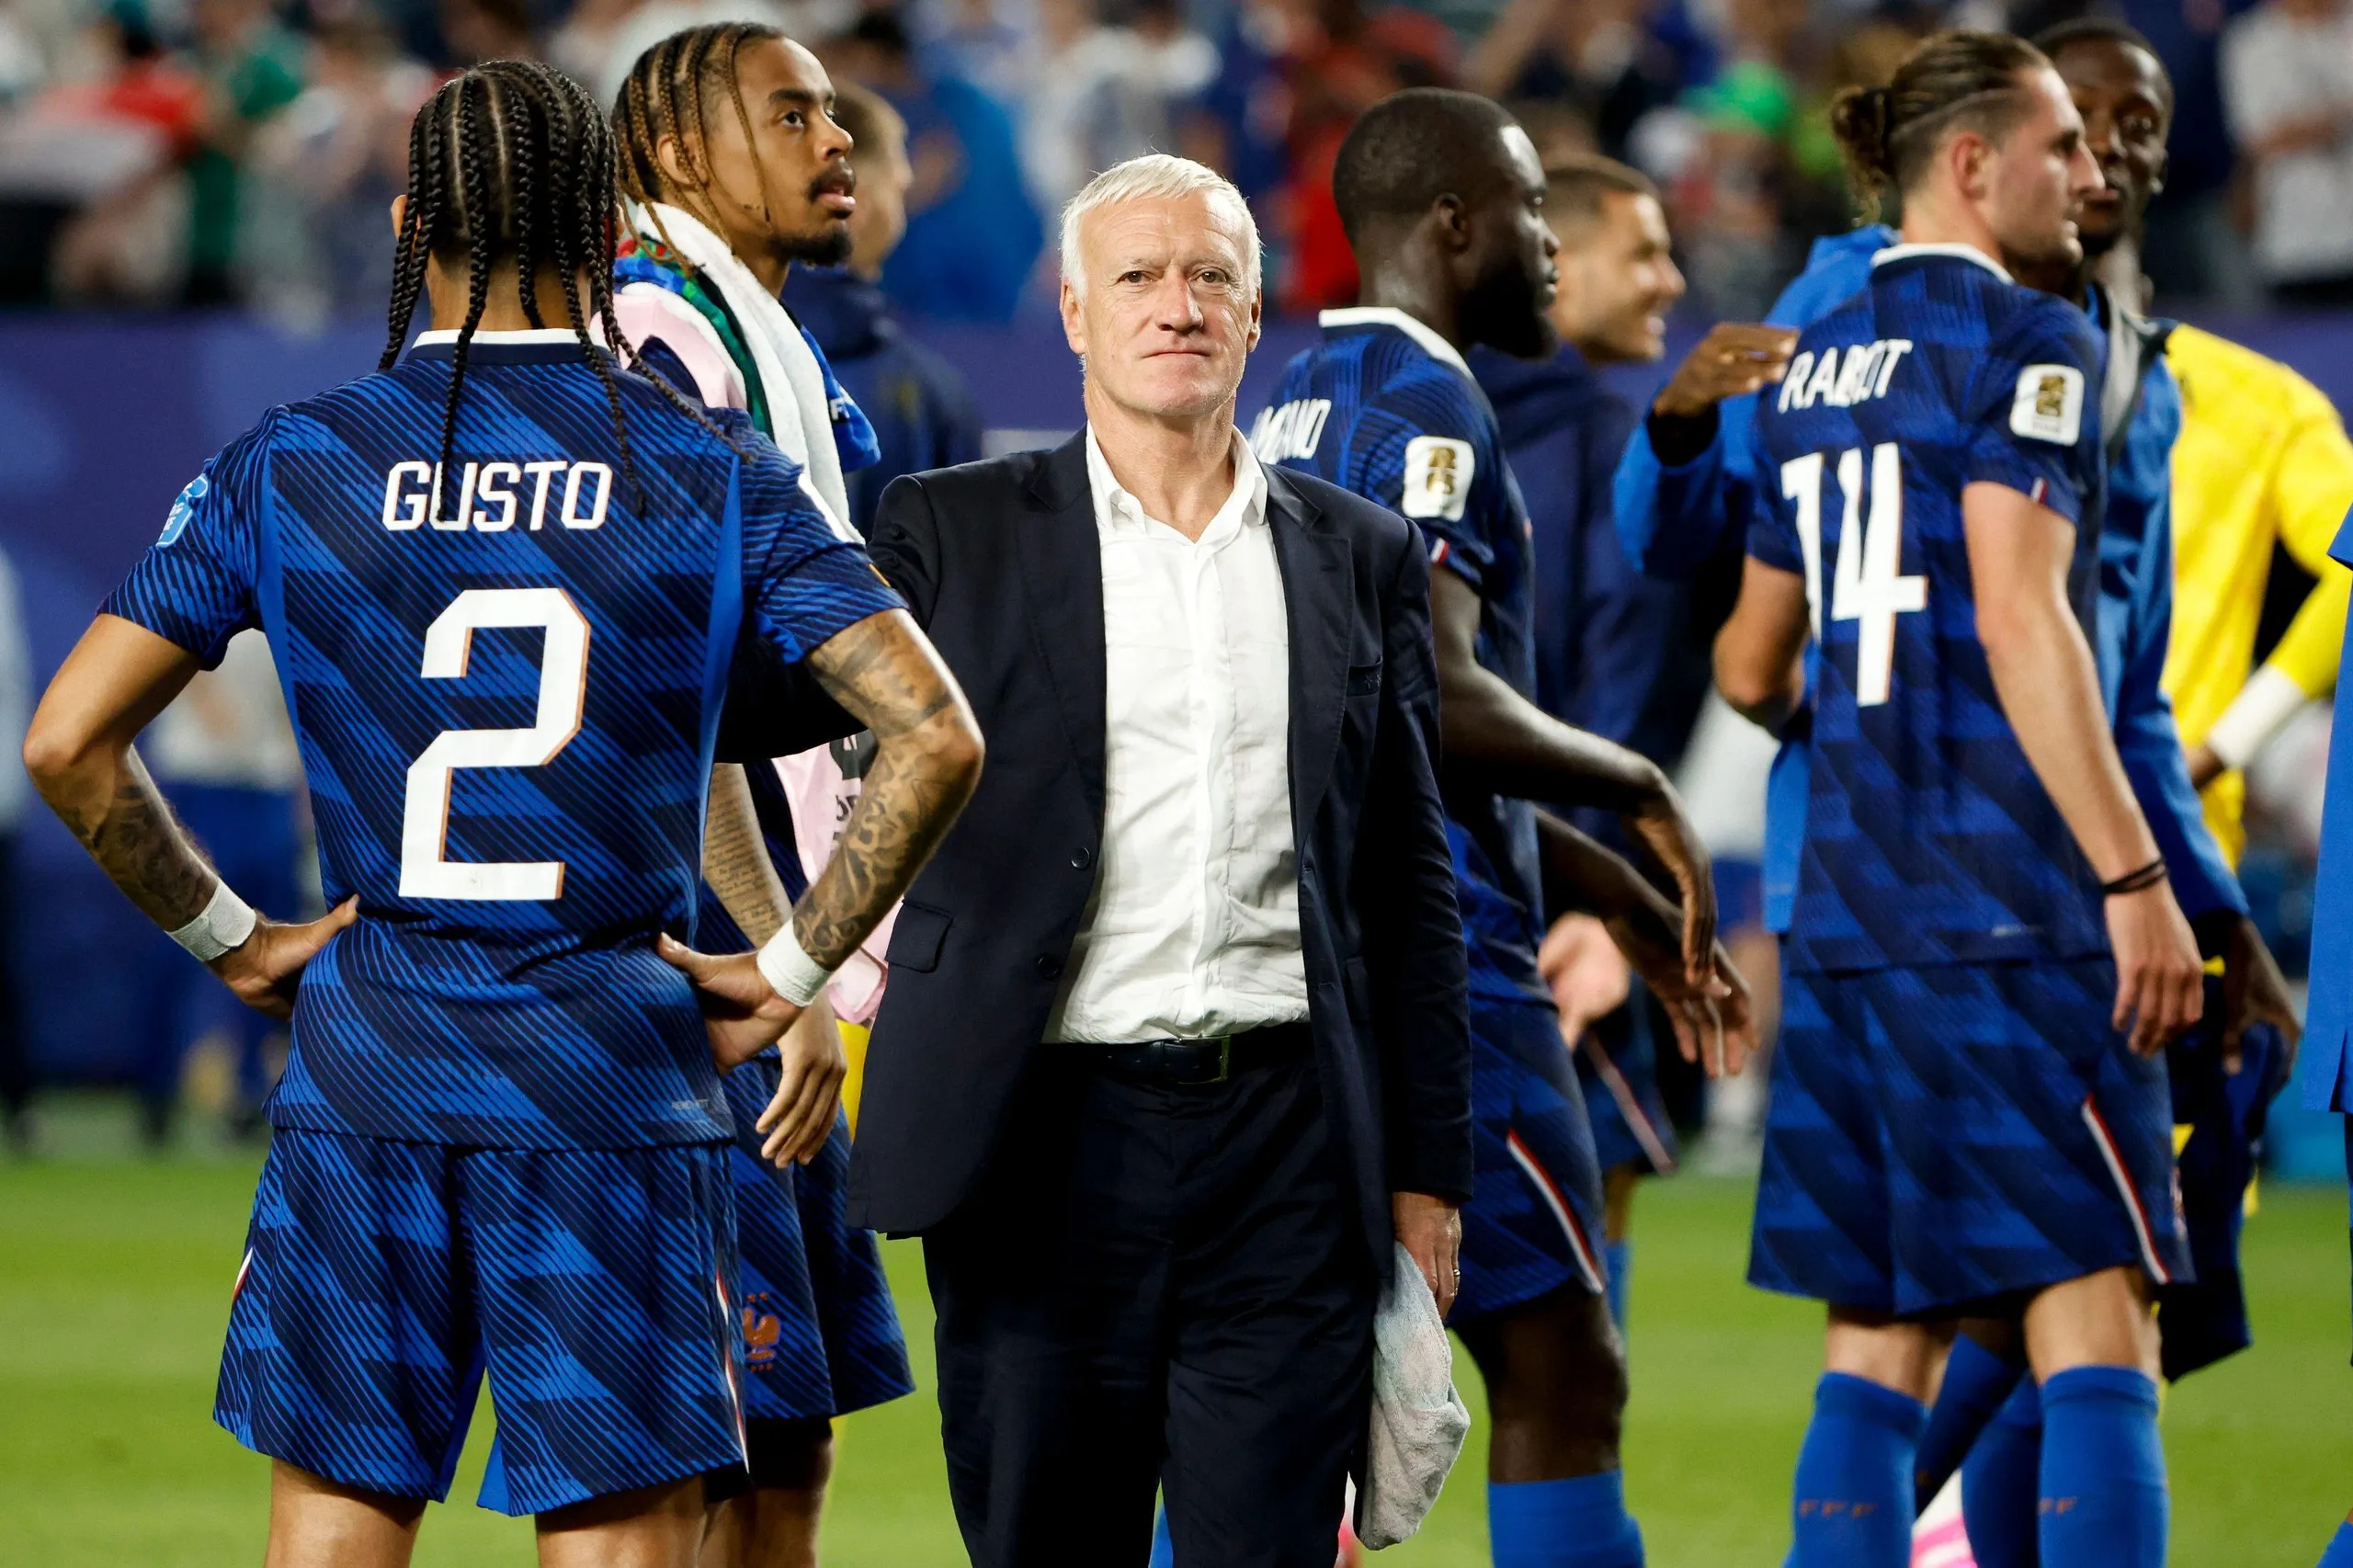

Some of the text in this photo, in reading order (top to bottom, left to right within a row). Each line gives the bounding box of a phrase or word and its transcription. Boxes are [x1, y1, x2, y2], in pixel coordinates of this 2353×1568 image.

[381, 460, 613, 532] GUSTO
[1780, 442, 1928, 708] 14
[398, 587, 591, 901] 2
